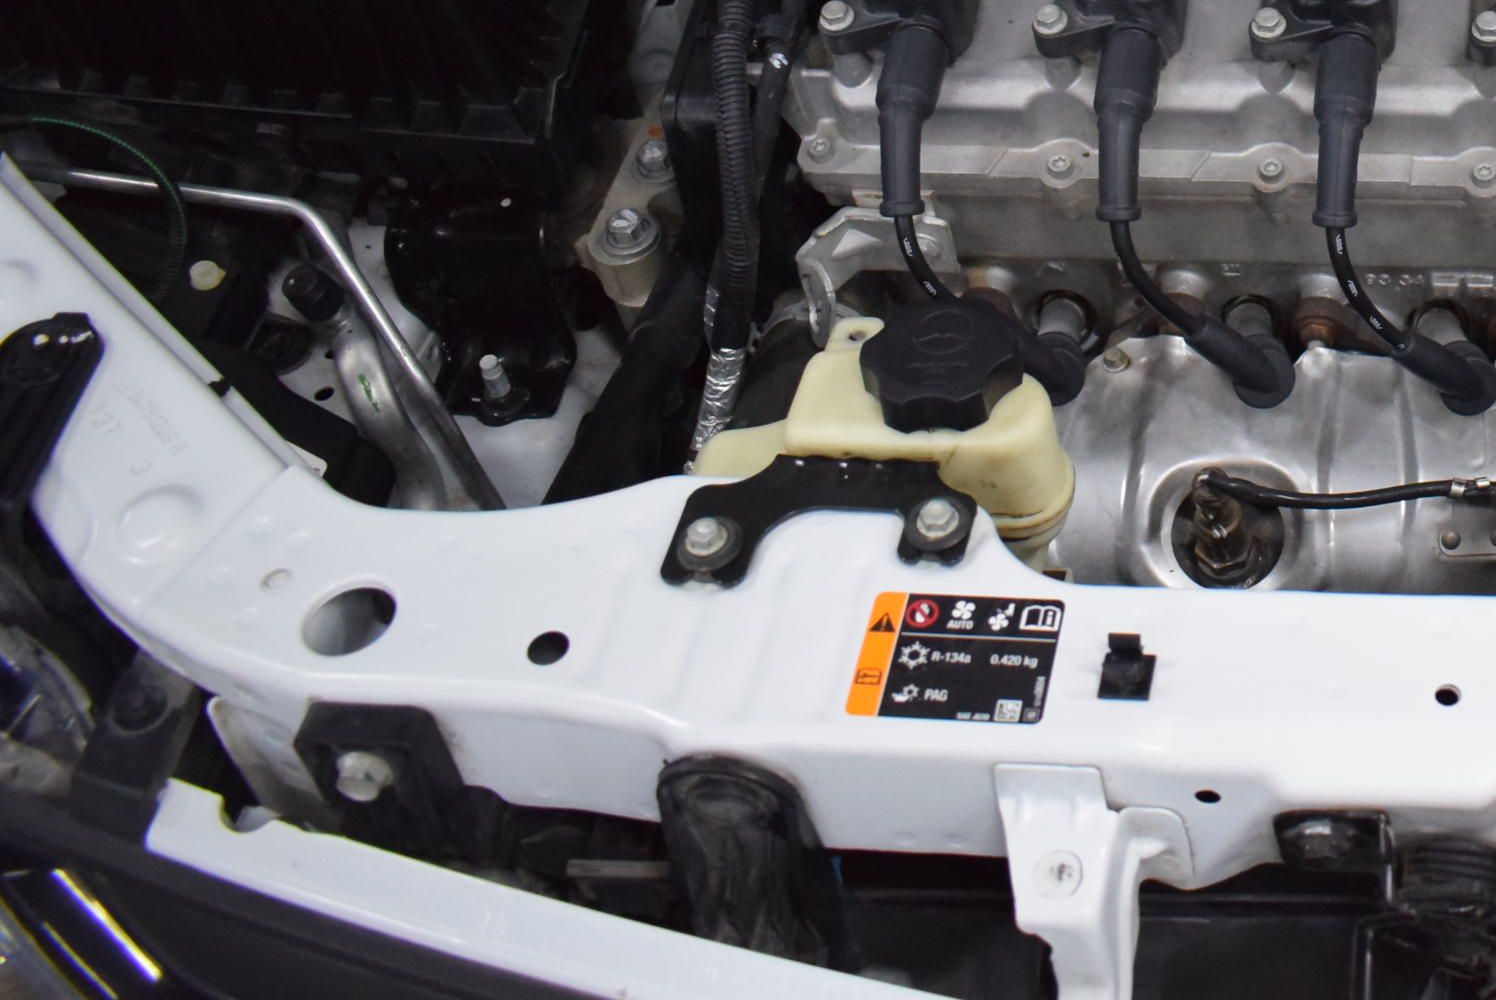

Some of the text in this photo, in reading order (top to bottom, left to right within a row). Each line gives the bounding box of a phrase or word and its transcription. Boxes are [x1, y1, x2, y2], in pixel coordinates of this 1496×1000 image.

[946, 619, 974, 630] AUTO
[931, 651, 1039, 669] R-134a 0.420 kg
[924, 688, 949, 702] PAG
